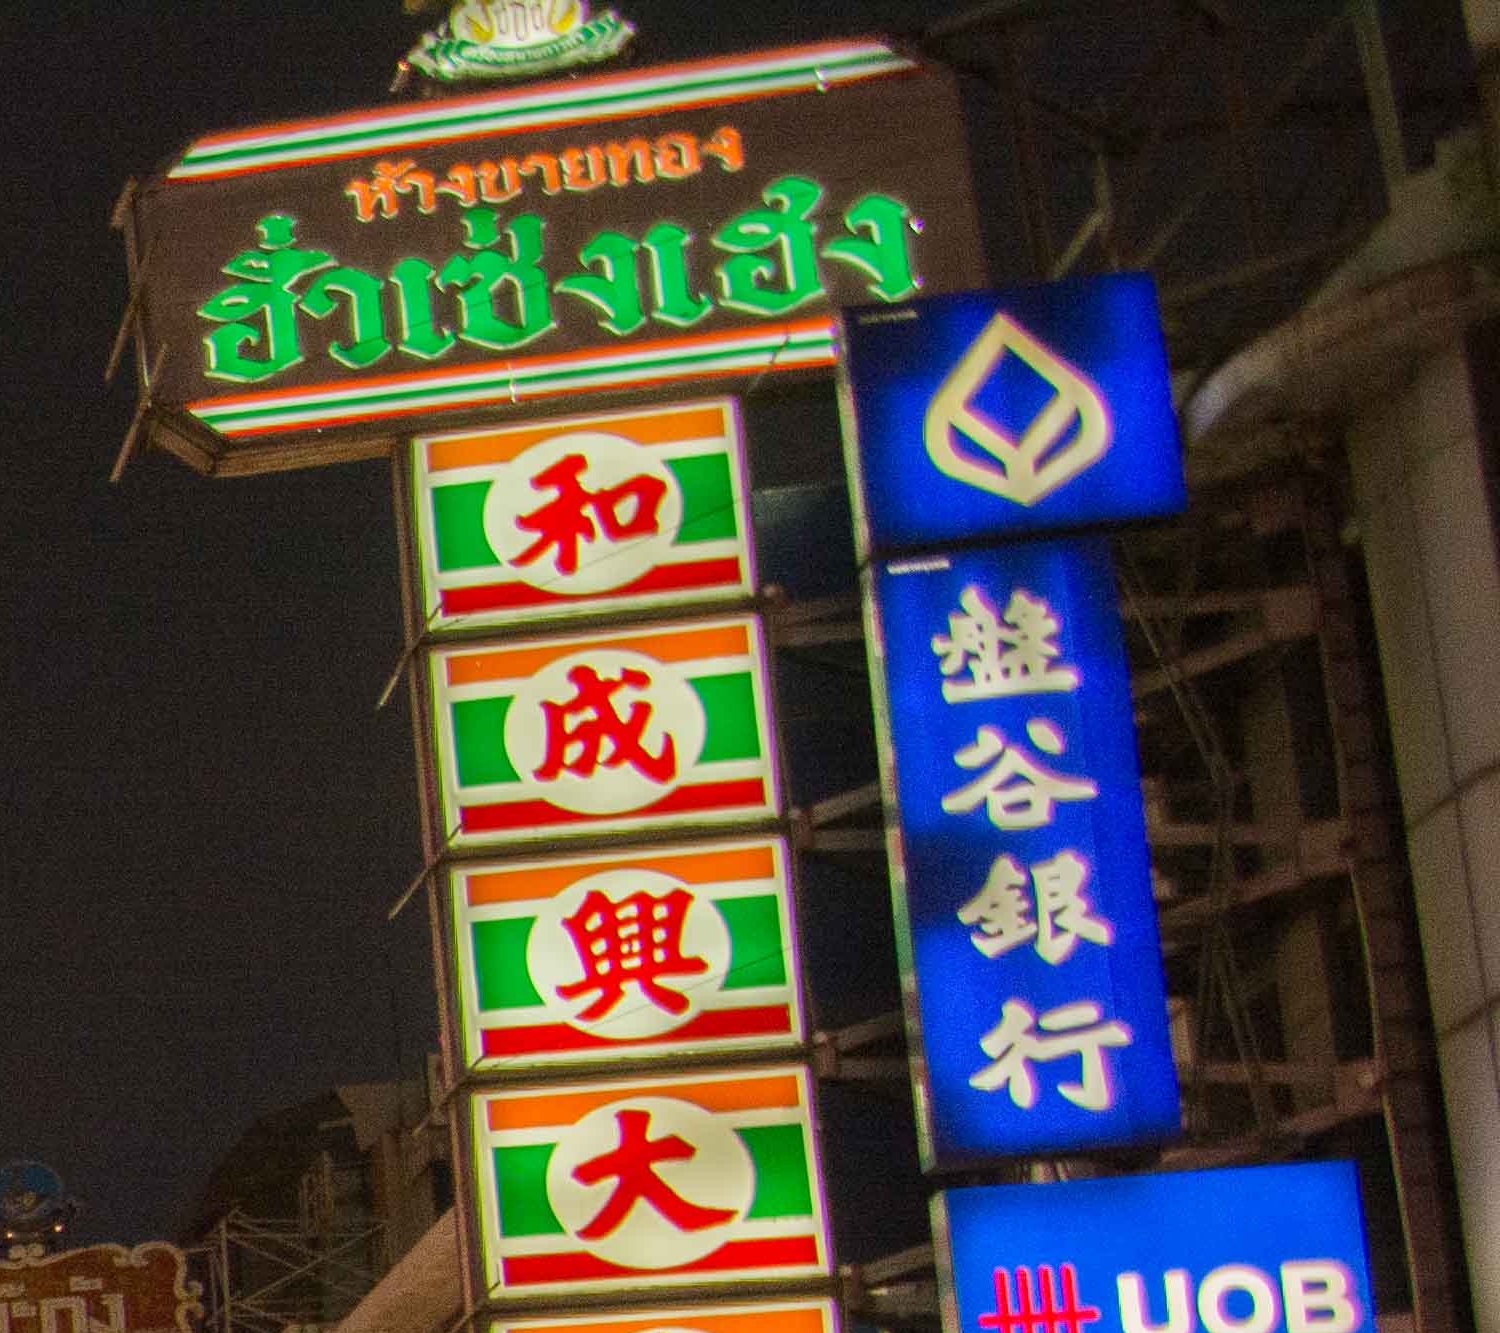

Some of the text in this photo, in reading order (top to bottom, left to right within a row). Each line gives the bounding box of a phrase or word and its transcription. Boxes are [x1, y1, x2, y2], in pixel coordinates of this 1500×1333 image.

[345, 126, 743, 222] ห้างขายทอง
[197, 175, 918, 384] ฮั่วเซ่งเฮง
[932, 584, 1132, 1112] 盤谷銀行
